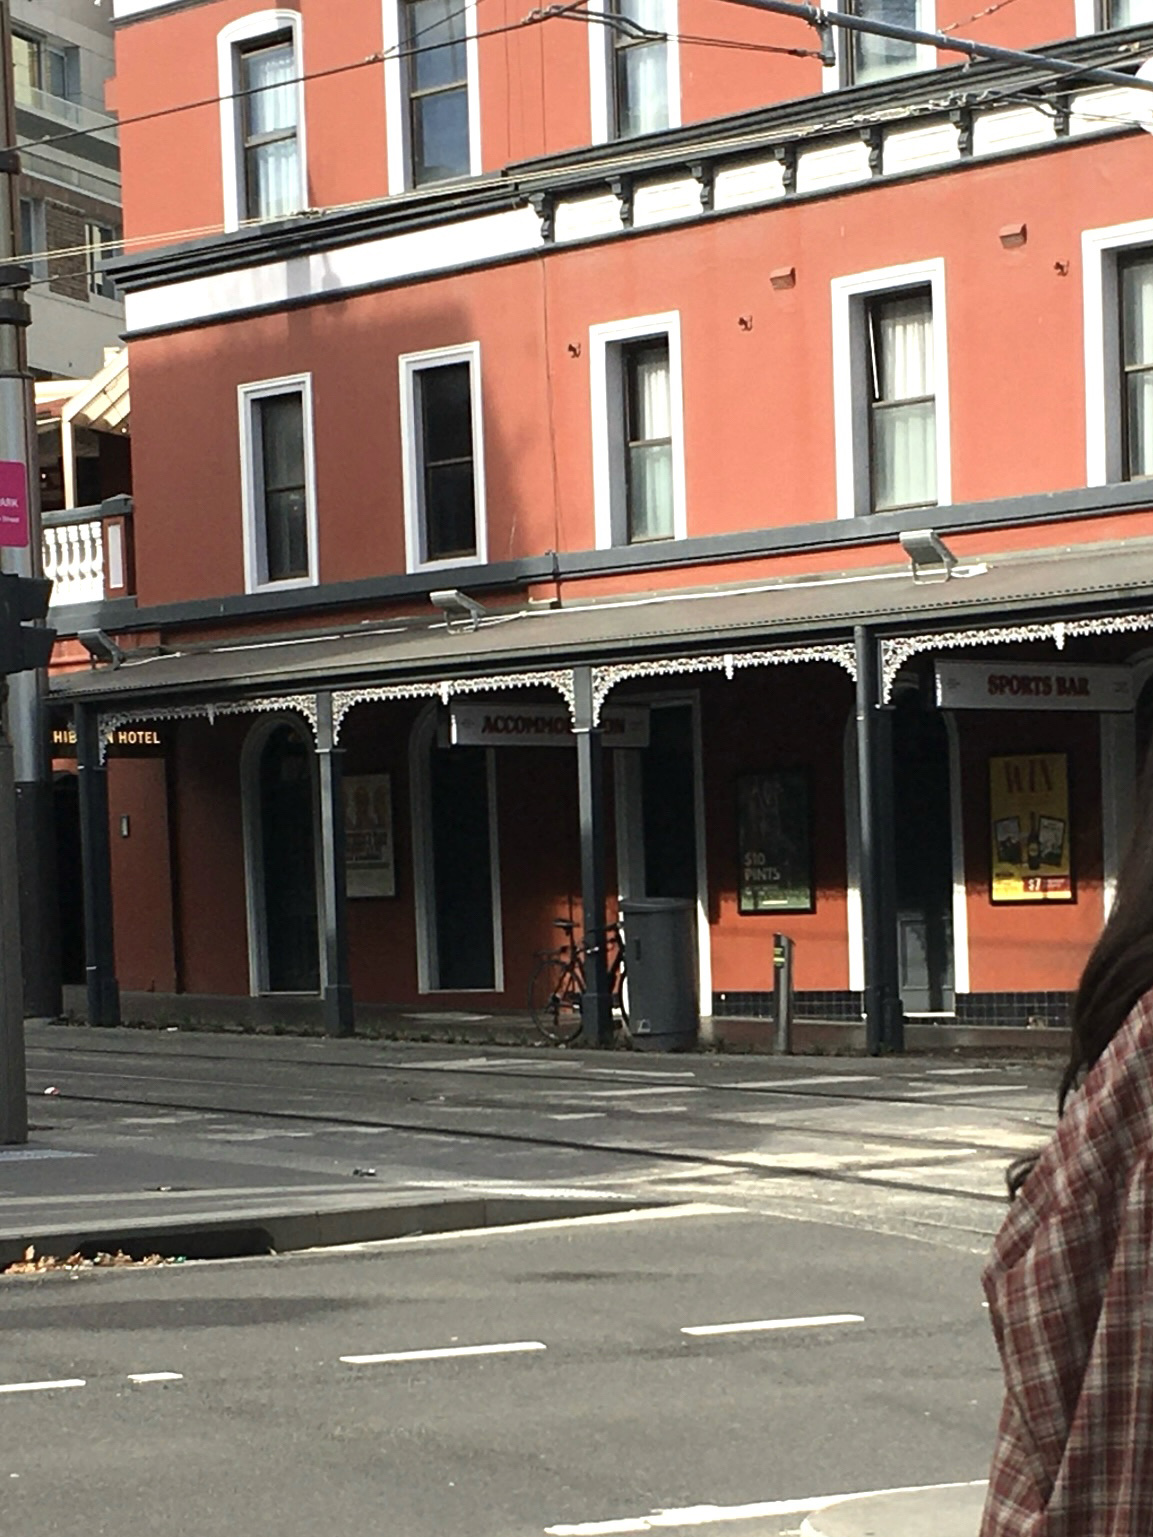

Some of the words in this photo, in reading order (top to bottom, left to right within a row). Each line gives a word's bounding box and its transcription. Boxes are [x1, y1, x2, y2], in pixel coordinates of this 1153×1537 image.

[986, 674, 1052, 695] SPORTS
[1055, 676, 1089, 696] BAR
[117, 730, 162, 744] HOTEL
[744, 866, 781, 881] PINTS
